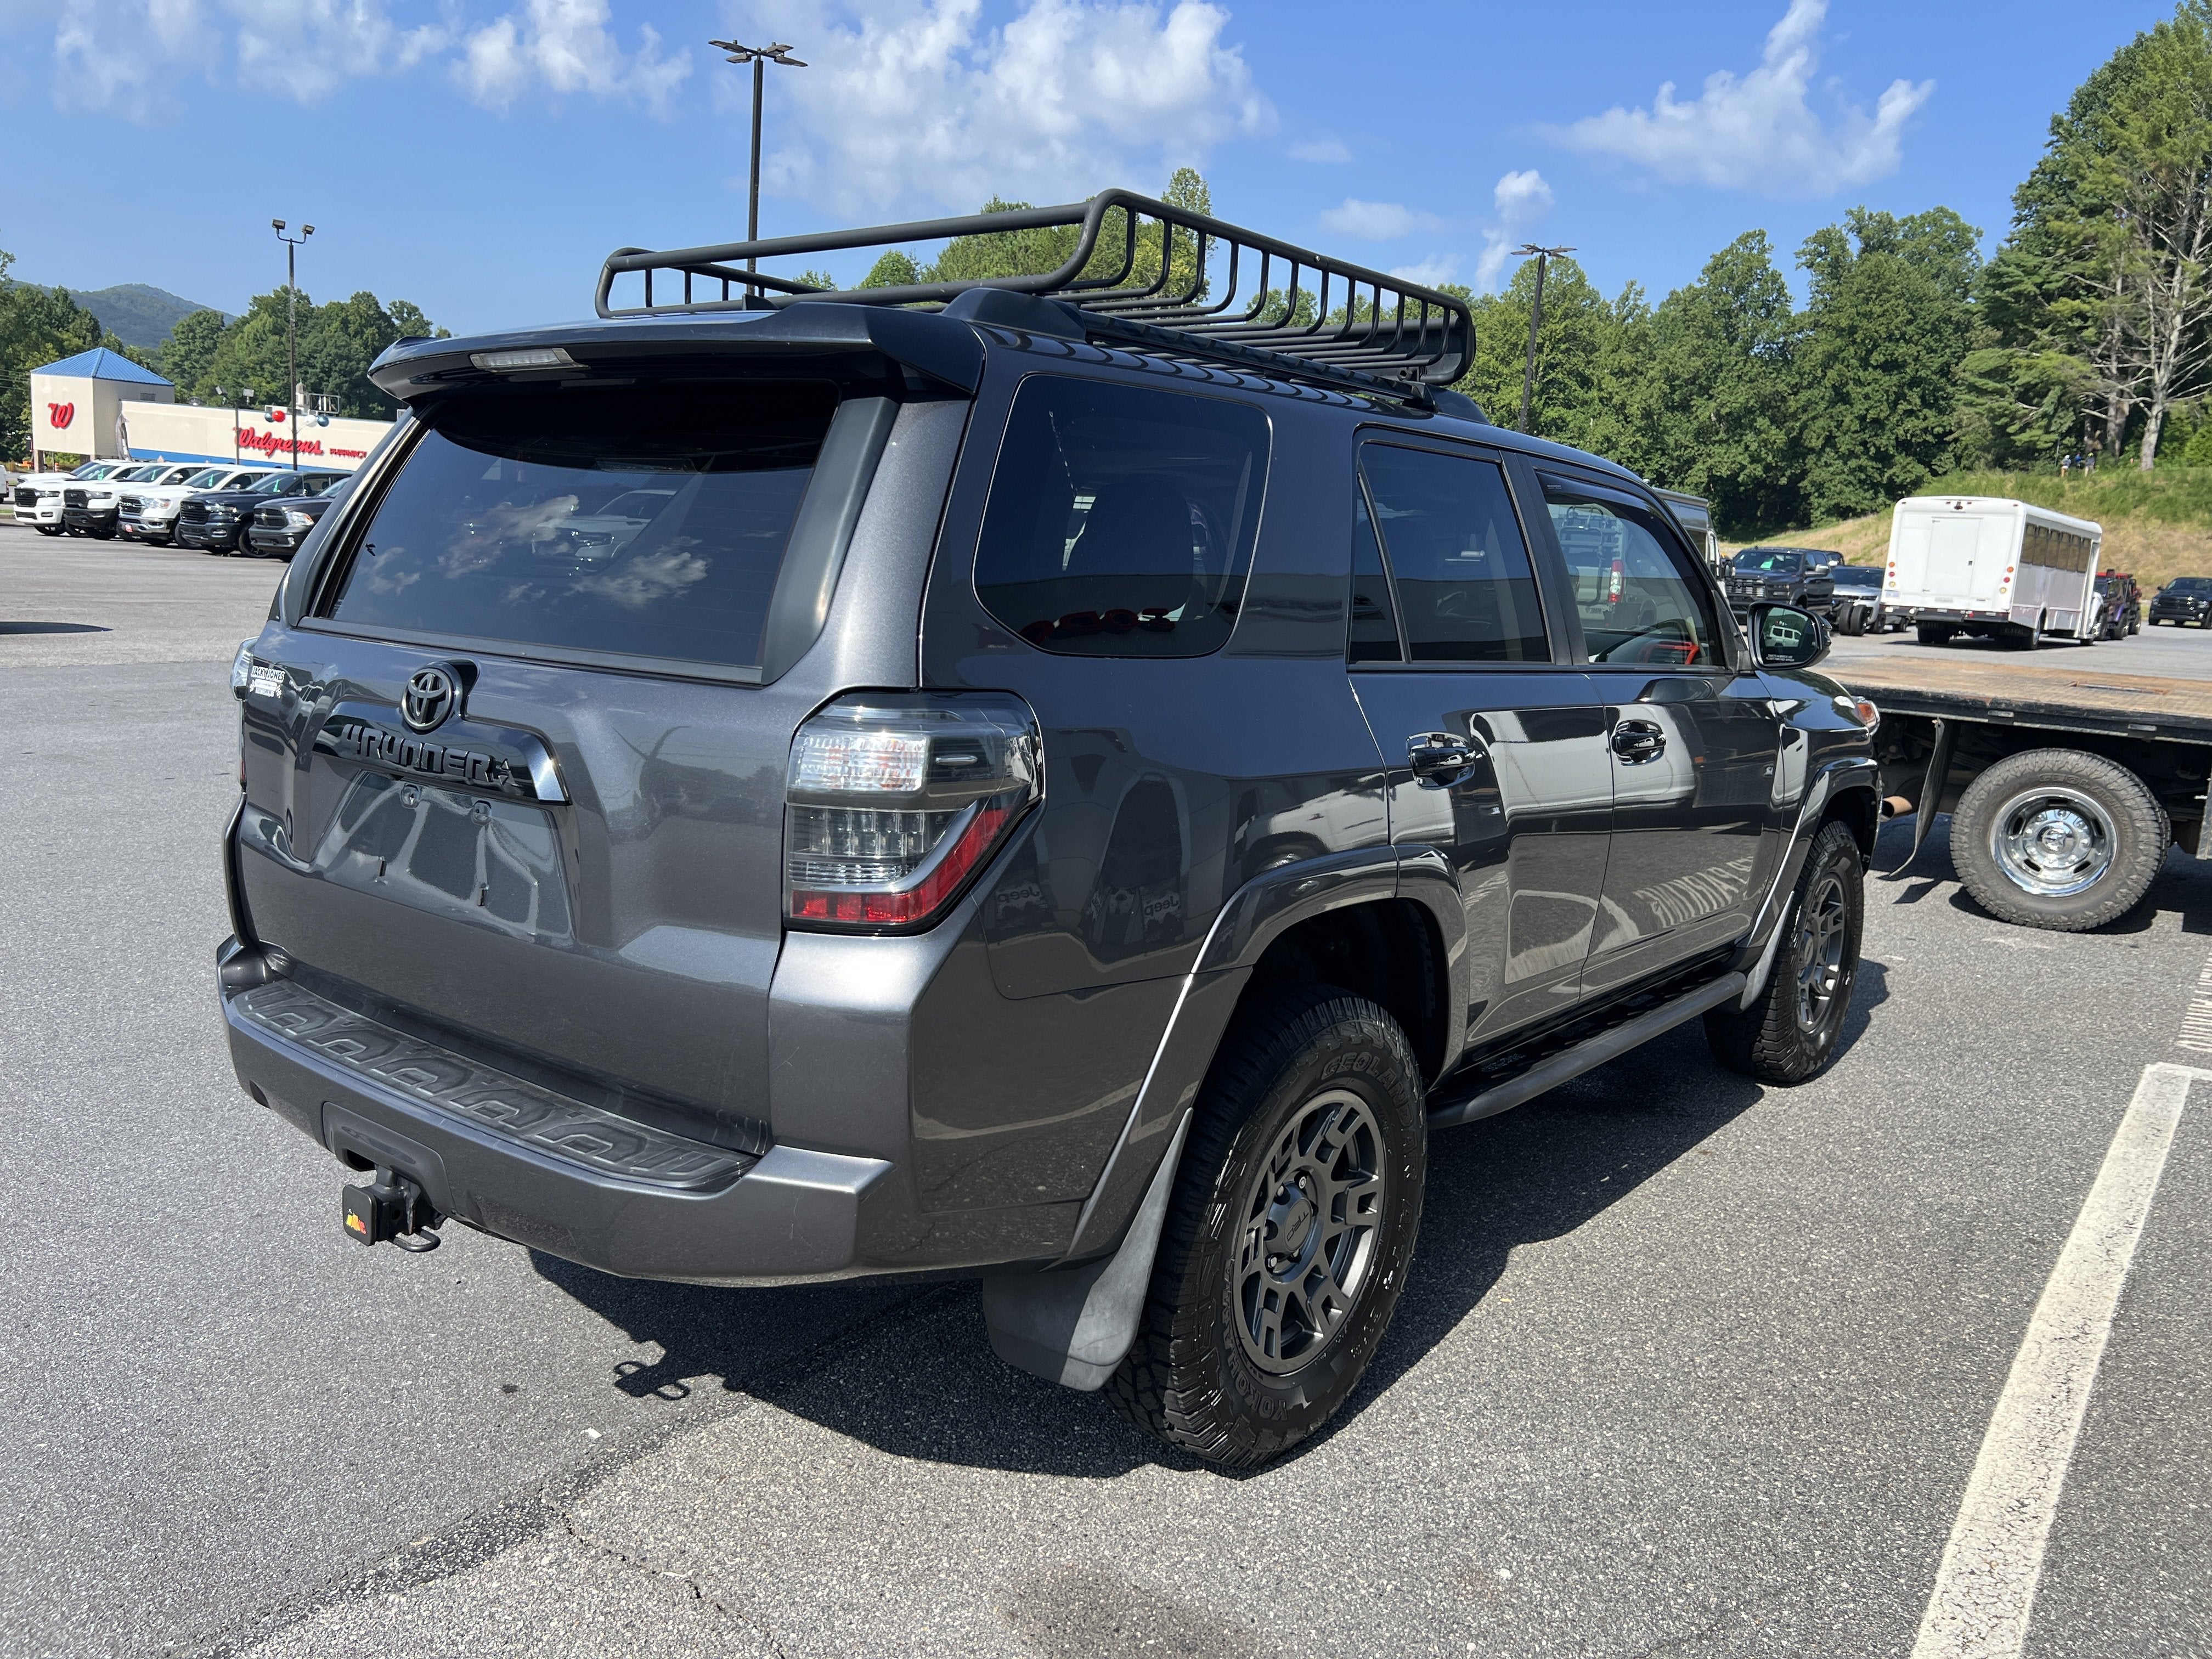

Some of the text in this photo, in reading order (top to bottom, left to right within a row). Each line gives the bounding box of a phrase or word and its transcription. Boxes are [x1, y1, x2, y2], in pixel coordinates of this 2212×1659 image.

[48, 402, 74, 429] W
[233, 427, 324, 459] Walgreens
[252, 666, 284, 681] JACKY JONES
[342, 724, 494, 782] 4RUNNER
[1321, 1052, 1418, 1180] GEOLANDAR
[1286, 1211, 1309, 1242] TRD
[1222, 1257, 1288, 1420] YOKOHAMA
